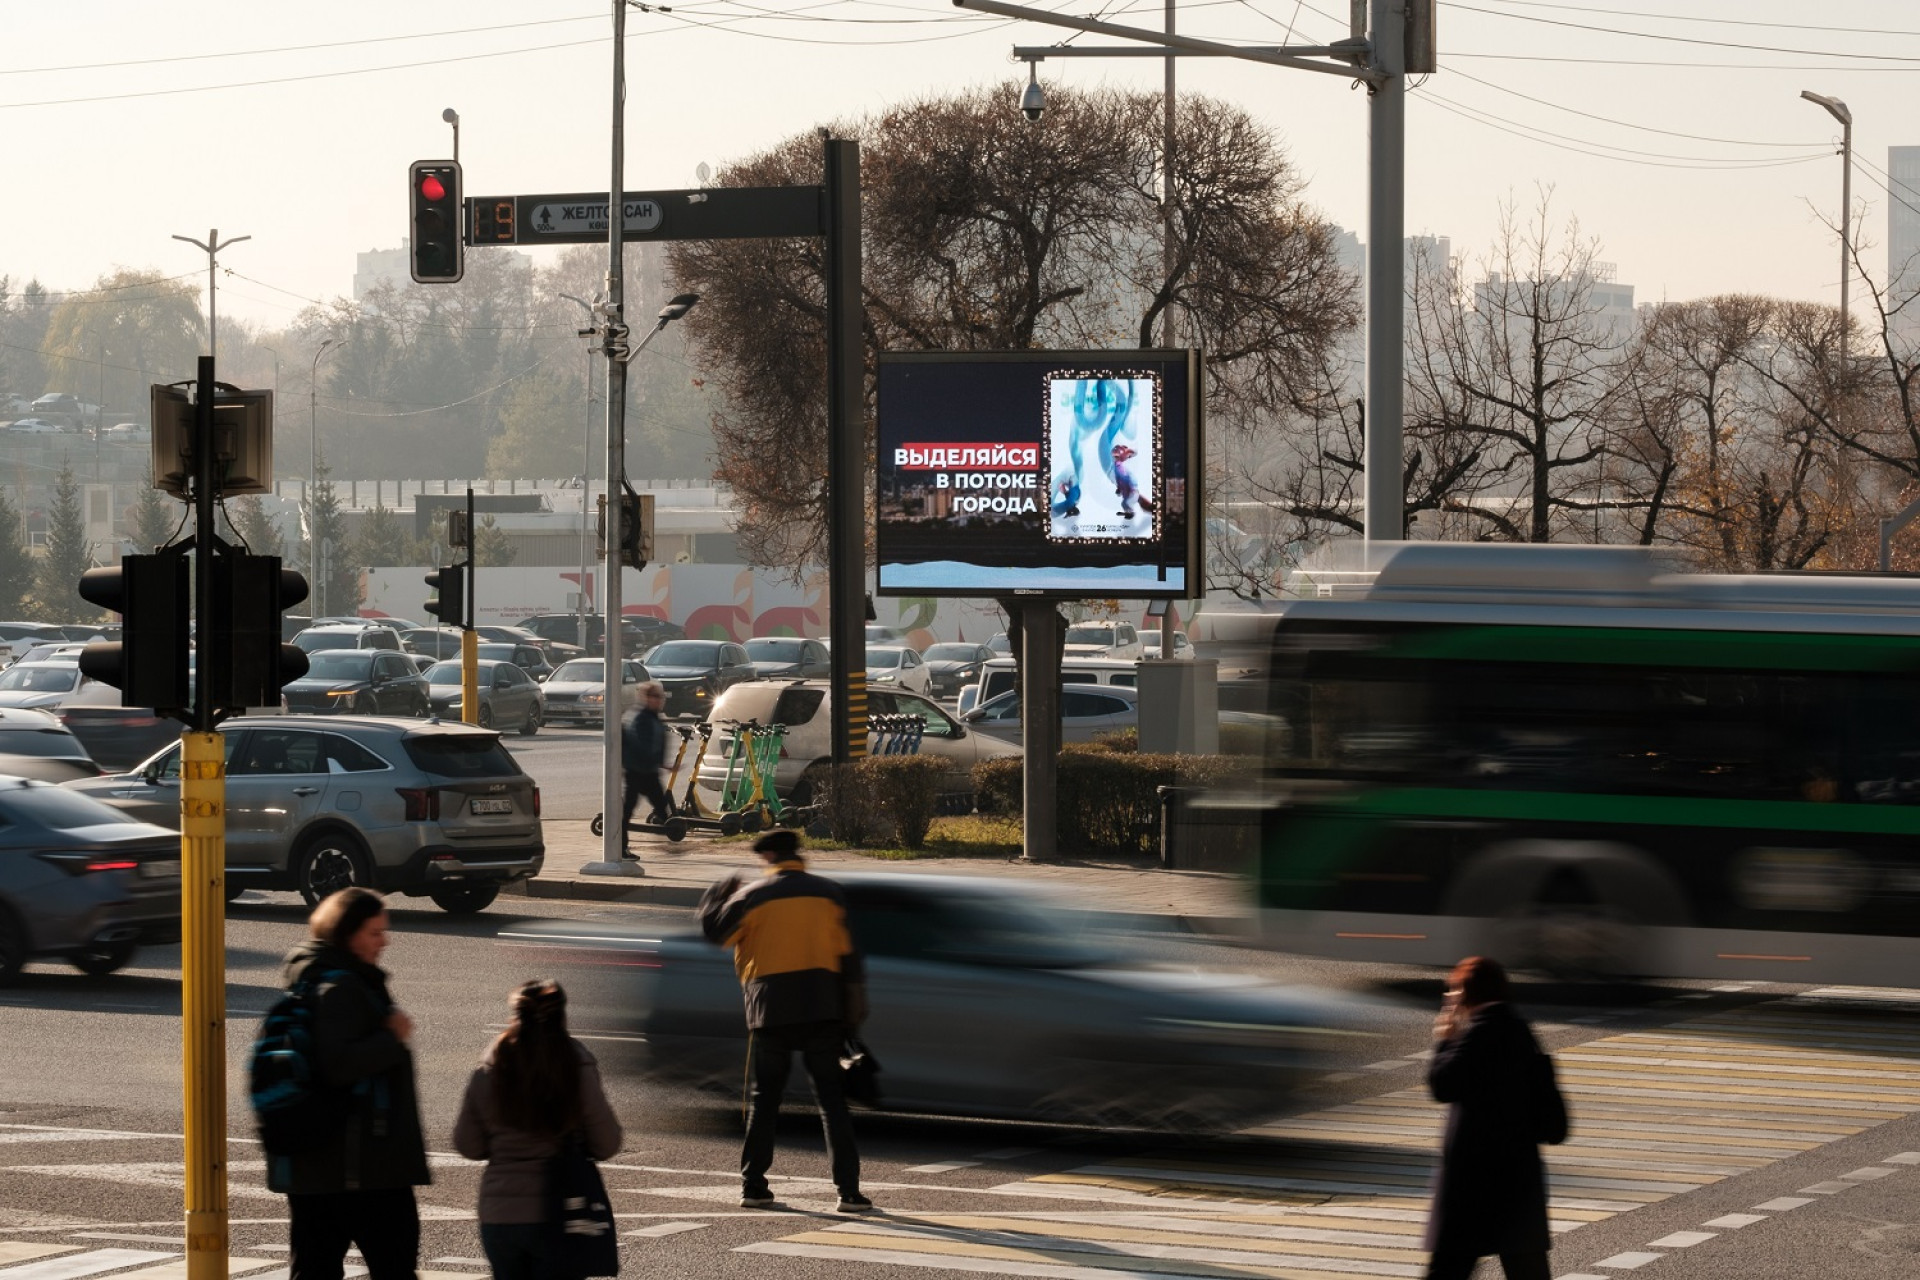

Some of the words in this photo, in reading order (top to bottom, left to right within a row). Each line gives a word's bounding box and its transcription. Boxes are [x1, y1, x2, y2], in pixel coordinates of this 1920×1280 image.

[475, 202, 514, 239] 19
[562, 204, 652, 220] ЖЕЛТОСАН
[895, 444, 1037, 468] ВЫДЕЛЯЙСЯ
[936, 473, 950, 489] В
[955, 473, 1037, 489] ПОТОКЕ
[953, 497, 1037, 515] ГОРОДА
[1096, 524, 1107, 532] 26
